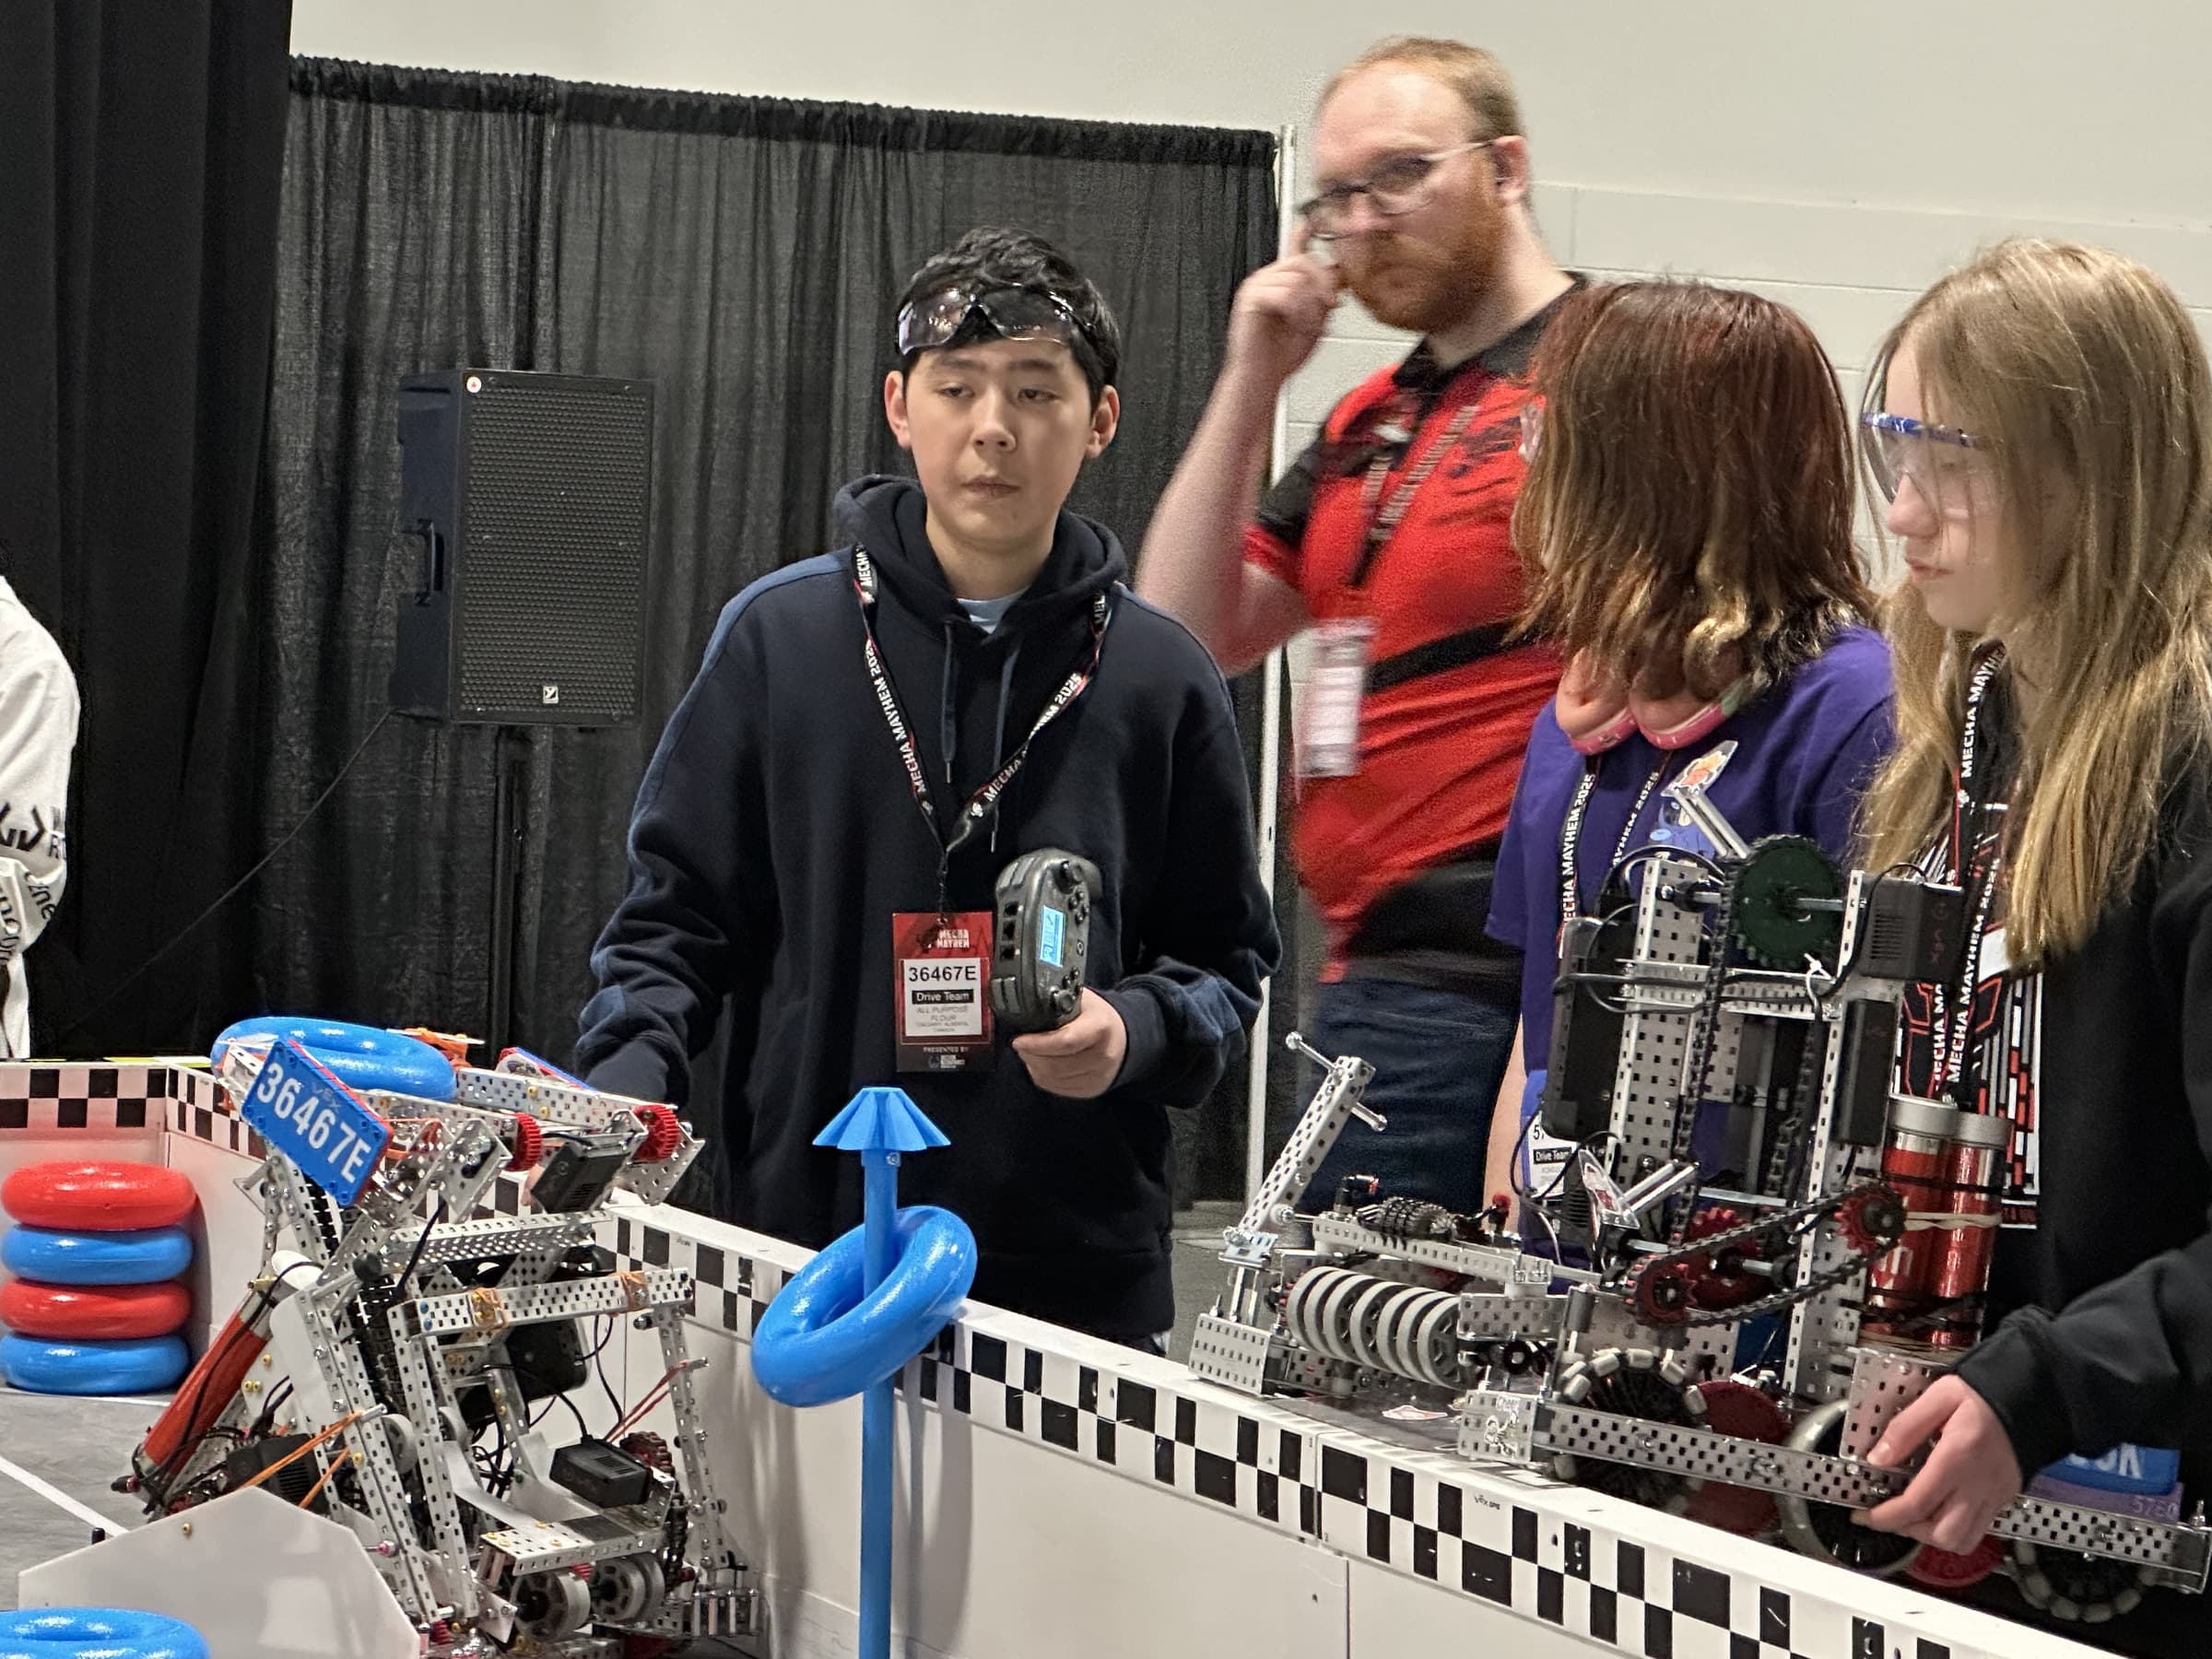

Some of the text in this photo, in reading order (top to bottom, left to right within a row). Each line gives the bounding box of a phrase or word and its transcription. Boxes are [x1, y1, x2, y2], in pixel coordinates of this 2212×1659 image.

[855, 551, 873, 587] MECHA
[875, 677, 908, 741] MAYHEM
[983, 759, 1022, 802] MECHA
[1054, 673, 1082, 705] 2025
[900, 743, 925, 793] MECHA
[1960, 706, 1977, 778] MECHA
[1562, 773, 1596, 924] ECHA MAYHEM 2025
[1613, 812, 1638, 868] AYHEM
[936, 938, 970, 948] MAYHEM
[908, 965, 977, 982] 36467E
[915, 991, 970, 1003] Drive Team
[1947, 1009, 1969, 1084] MECHA
[1959, 913, 1984, 1005] MAYHEM
[255, 1061, 371, 1184] 36467E
